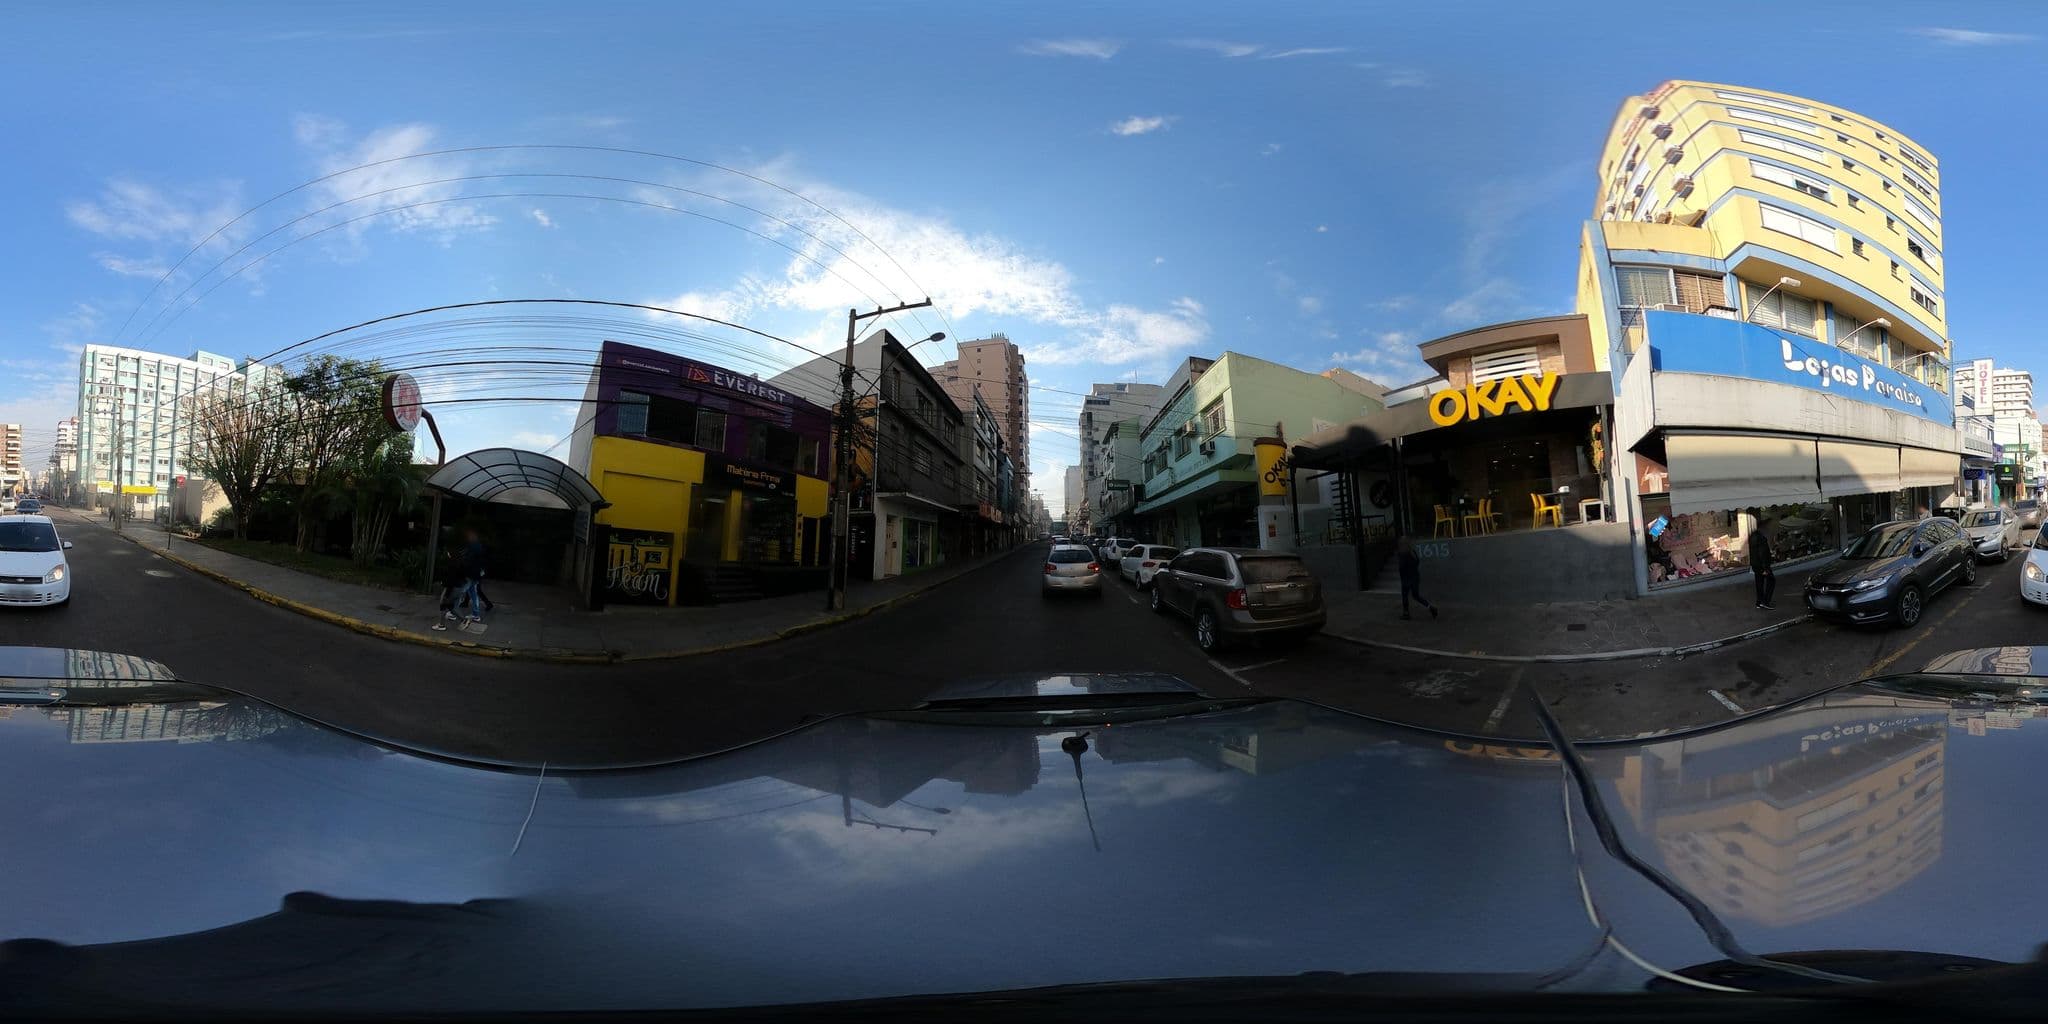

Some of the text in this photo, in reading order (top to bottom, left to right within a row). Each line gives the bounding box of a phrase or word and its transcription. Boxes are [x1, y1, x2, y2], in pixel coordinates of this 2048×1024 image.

[1781, 339, 1858, 388] Lojas
[1979, 362, 1988, 404] HOTEL
[713, 370, 786, 404] EVEREST
[1428, 370, 1560, 427] OKAY
[1416, 543, 1450, 559] 1615
